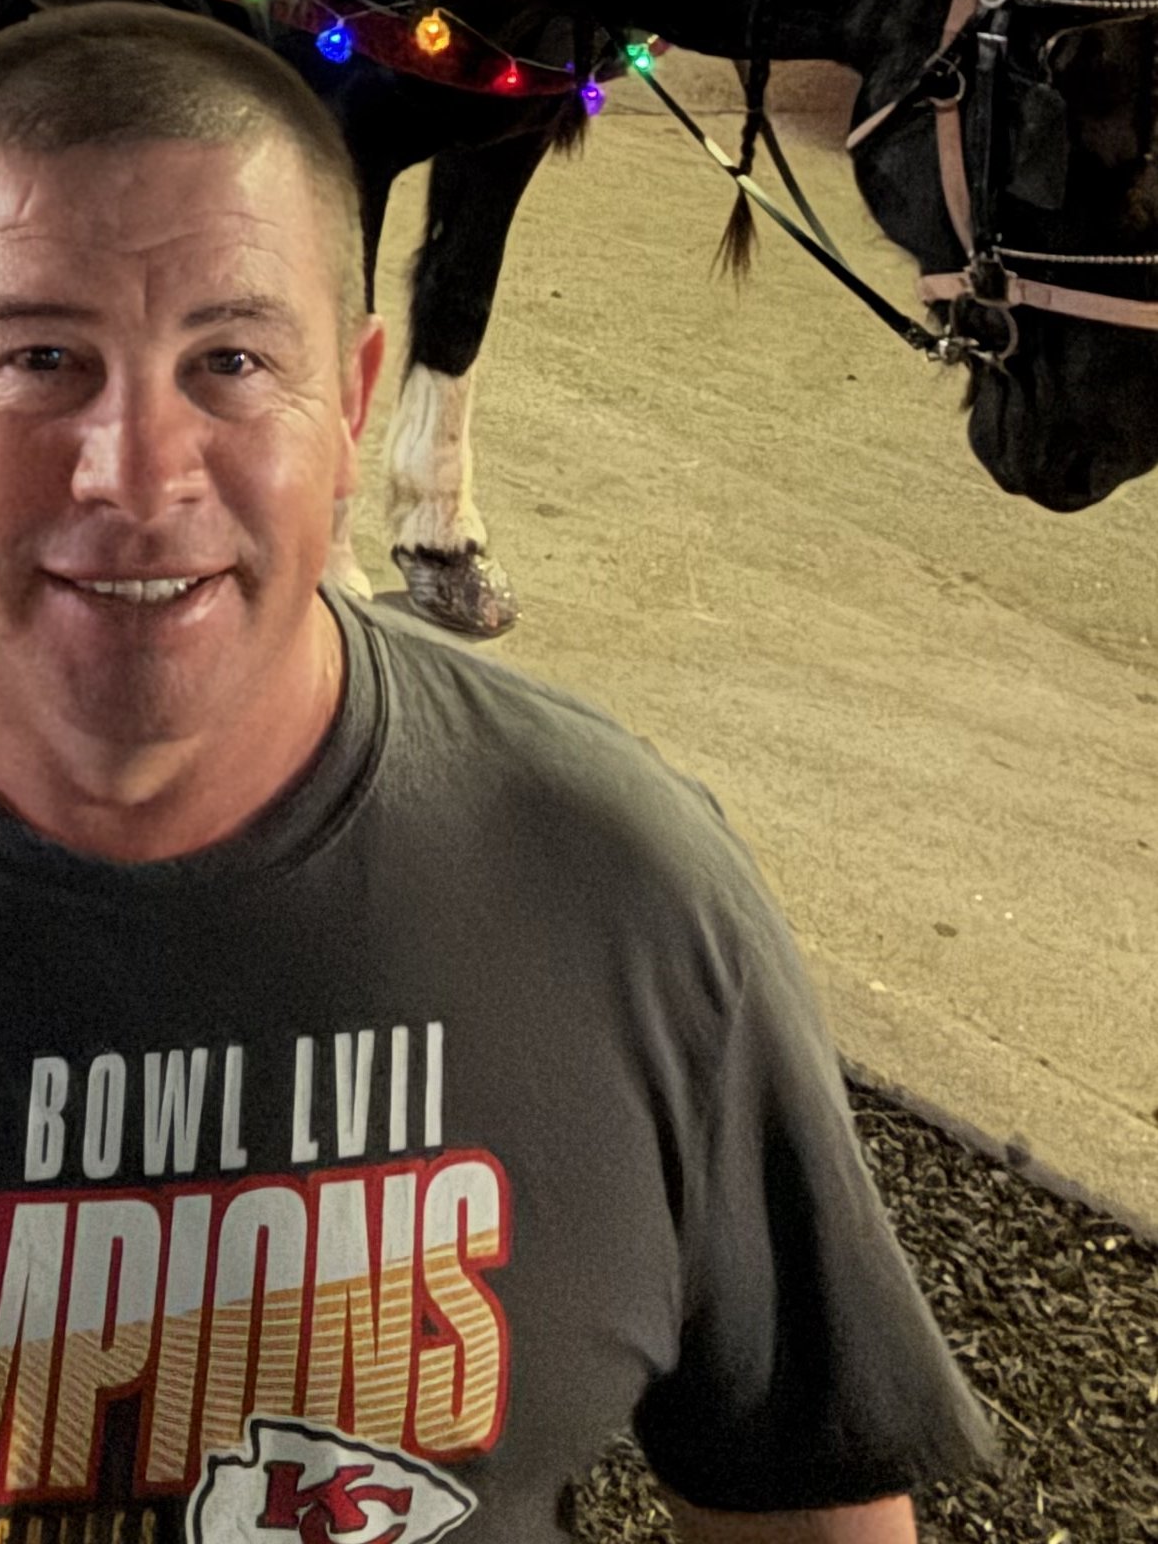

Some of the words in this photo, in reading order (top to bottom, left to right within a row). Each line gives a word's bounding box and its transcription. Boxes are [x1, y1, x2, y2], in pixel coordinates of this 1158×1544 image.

[24, 1044, 247, 1183] BOWL
[291, 1020, 443, 1164] LVII
[256, 1459, 413, 1544] KC
